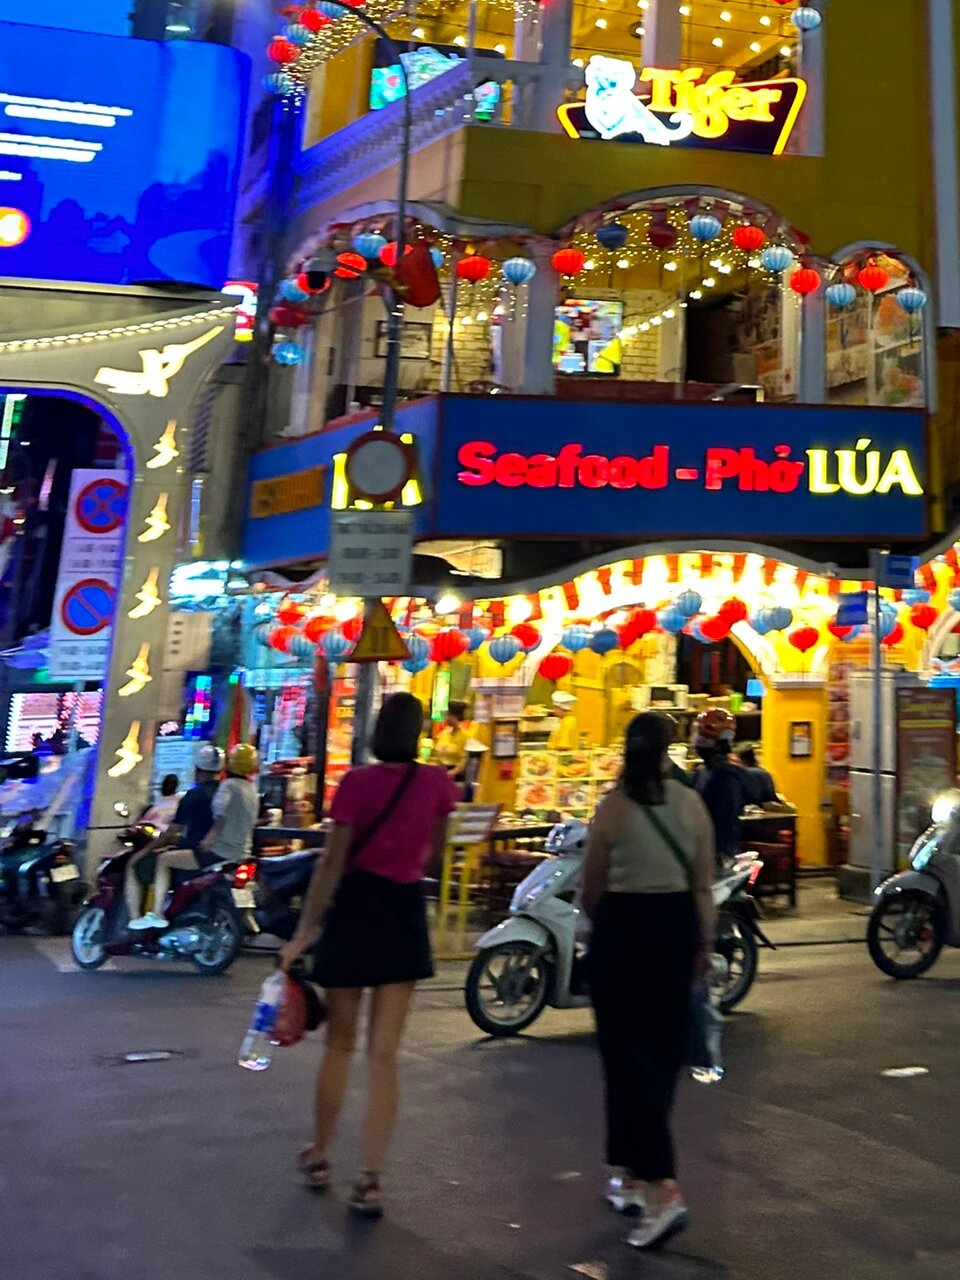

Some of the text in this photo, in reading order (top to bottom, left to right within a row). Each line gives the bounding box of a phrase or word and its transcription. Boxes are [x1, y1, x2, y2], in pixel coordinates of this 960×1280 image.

[639, 67, 782, 140] Tiger
[457, 440, 669, 490] Seafood
[704, 444, 805, 493] Phở
[805, 438, 924, 496] LÚA
